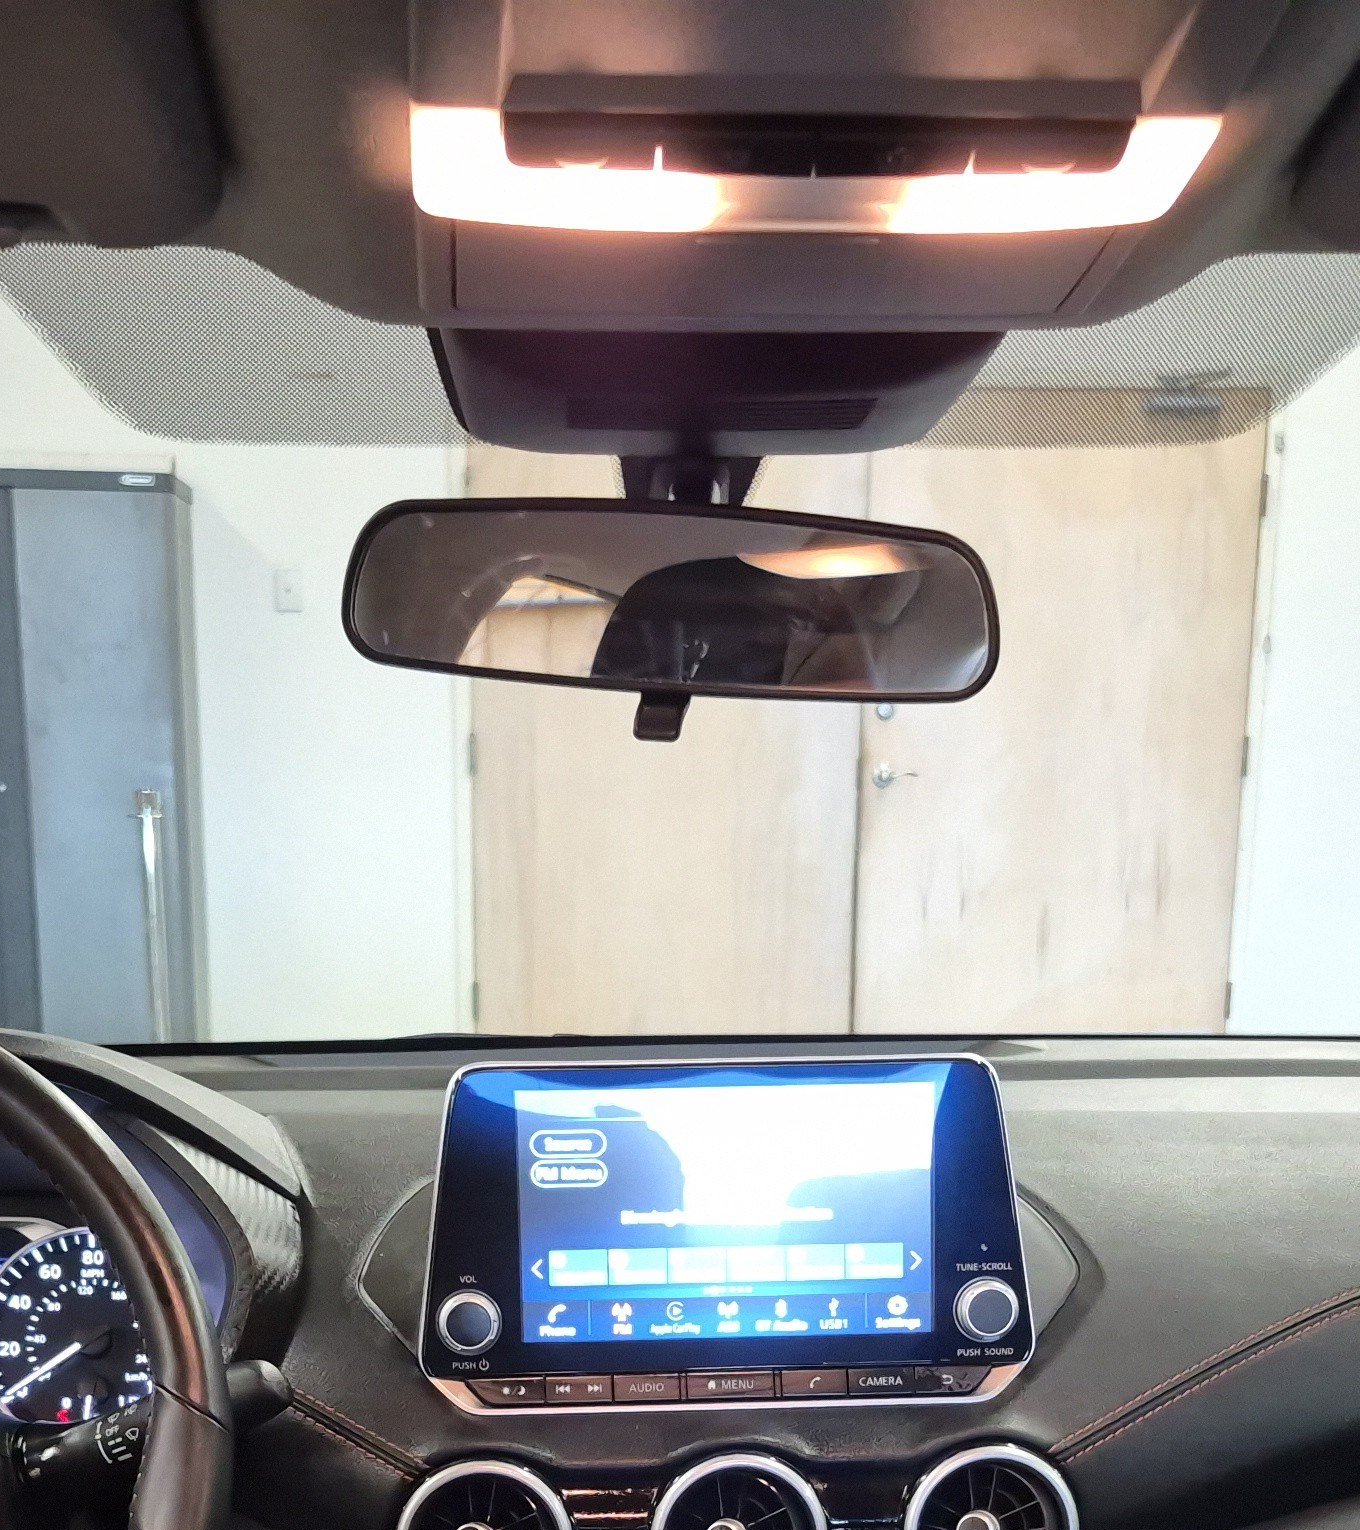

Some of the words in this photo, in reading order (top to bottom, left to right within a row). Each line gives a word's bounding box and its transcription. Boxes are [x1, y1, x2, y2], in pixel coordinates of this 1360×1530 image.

[81, 1250, 104, 1265] 80
[38, 1264, 62, 1280] 60
[459, 1275, 478, 1284] VOL
[7, 1294, 32, 1311] 40
[956, 1348, 981, 1357] PUSH
[984, 1347, 1014, 1356] SOUND
[452, 1361, 477, 1370] PUSH
[721, 1379, 755, 1390] MENU
[858, 1375, 904, 1387] CAMERA
[629, 1382, 665, 1393] AUDIO
